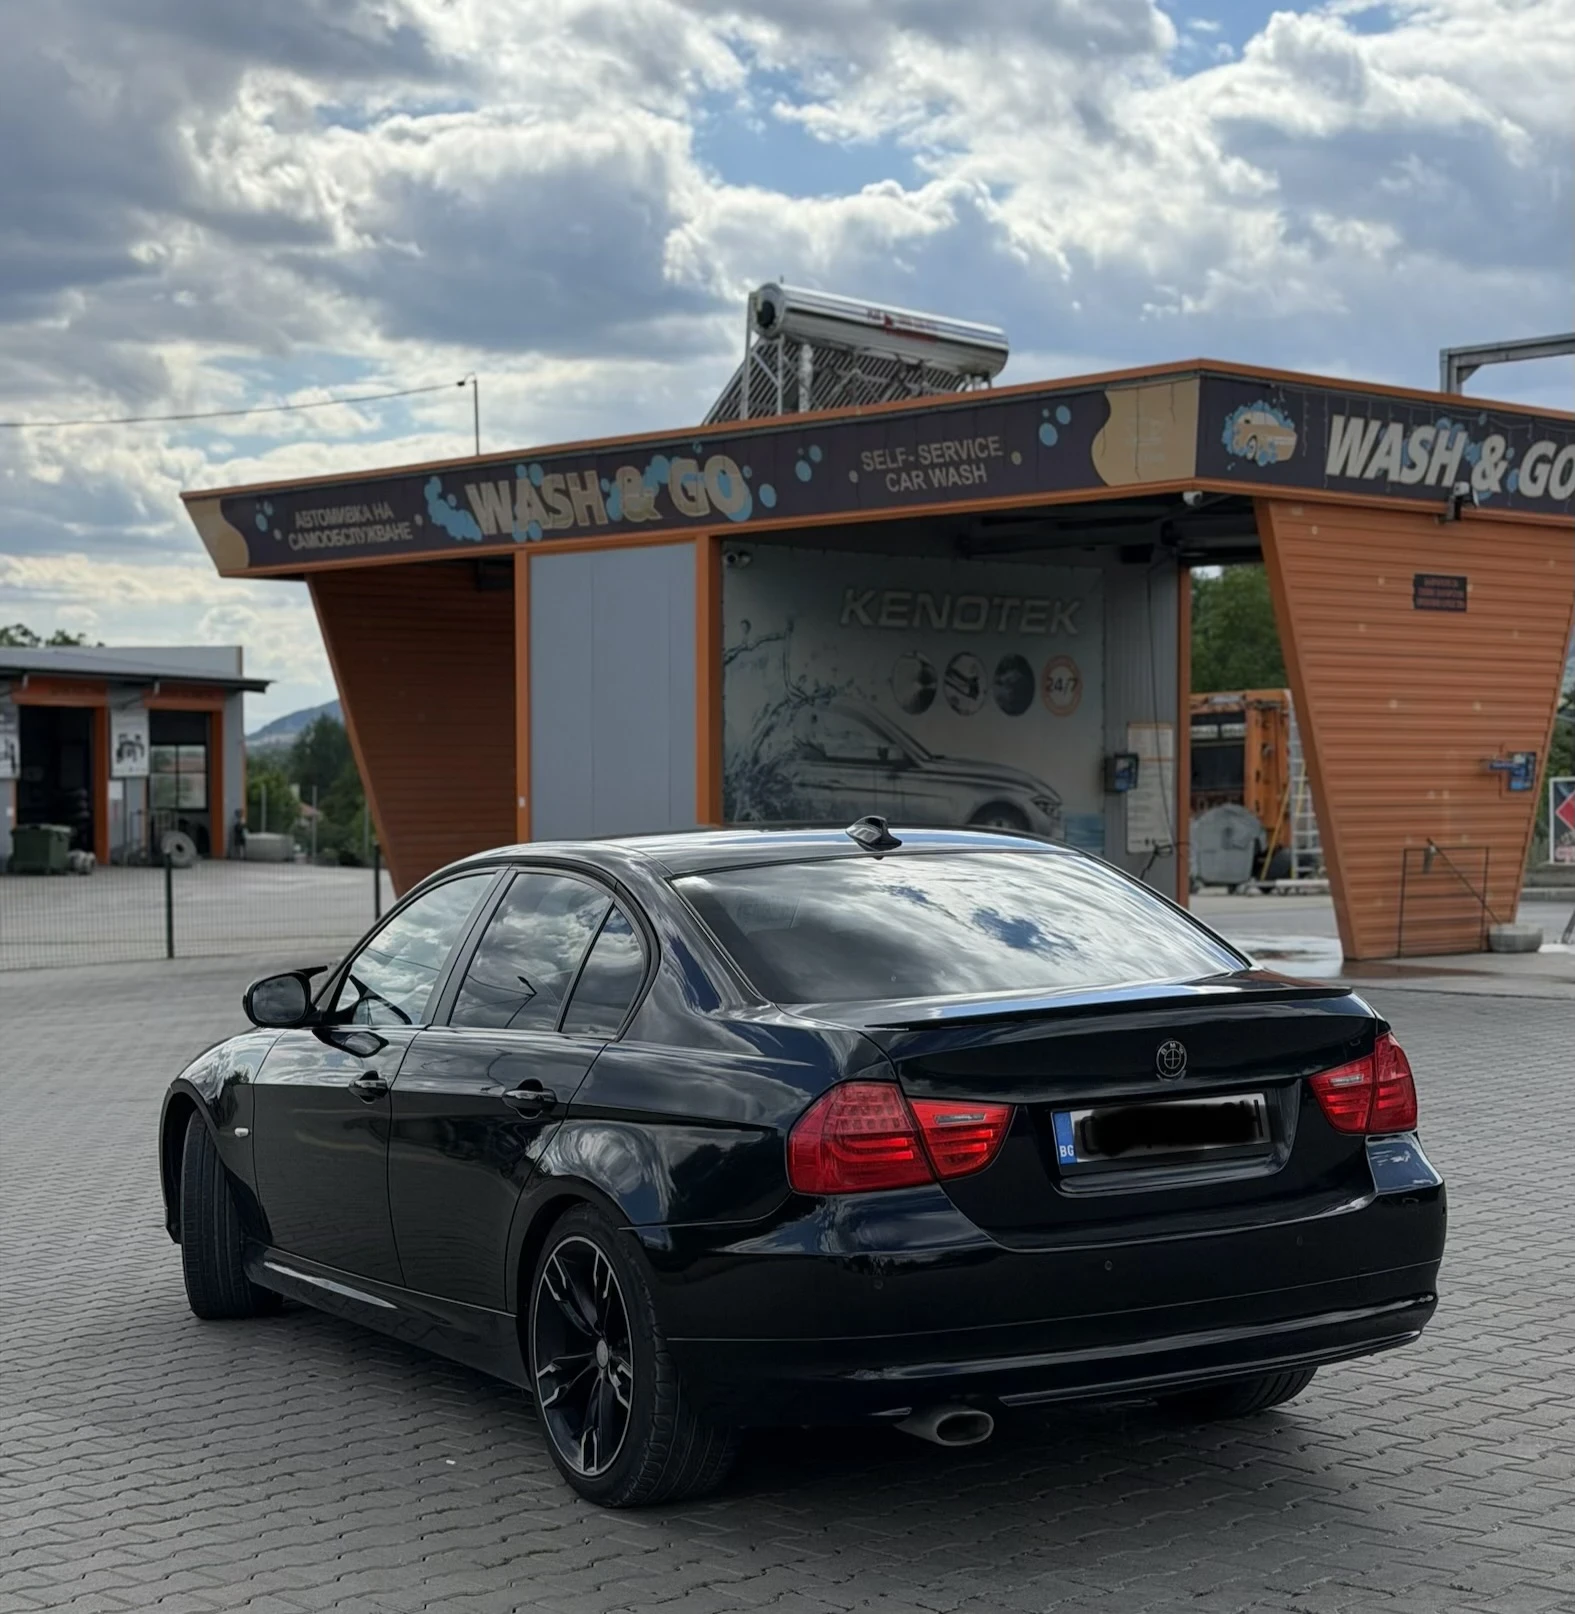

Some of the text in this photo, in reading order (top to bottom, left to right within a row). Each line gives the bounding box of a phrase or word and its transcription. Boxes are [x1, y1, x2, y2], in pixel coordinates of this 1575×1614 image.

[1325, 414, 1575, 500] WASH & GO
[885, 462, 987, 492] CAR WASH
[464, 455, 745, 536] WASH & GO
[295, 501, 394, 529] АВТОМИВКА НА
[840, 588, 1080, 635] KENOTEK
[1045, 675, 1078, 697] 24/7
[1060, 1145, 1074, 1157] BG
